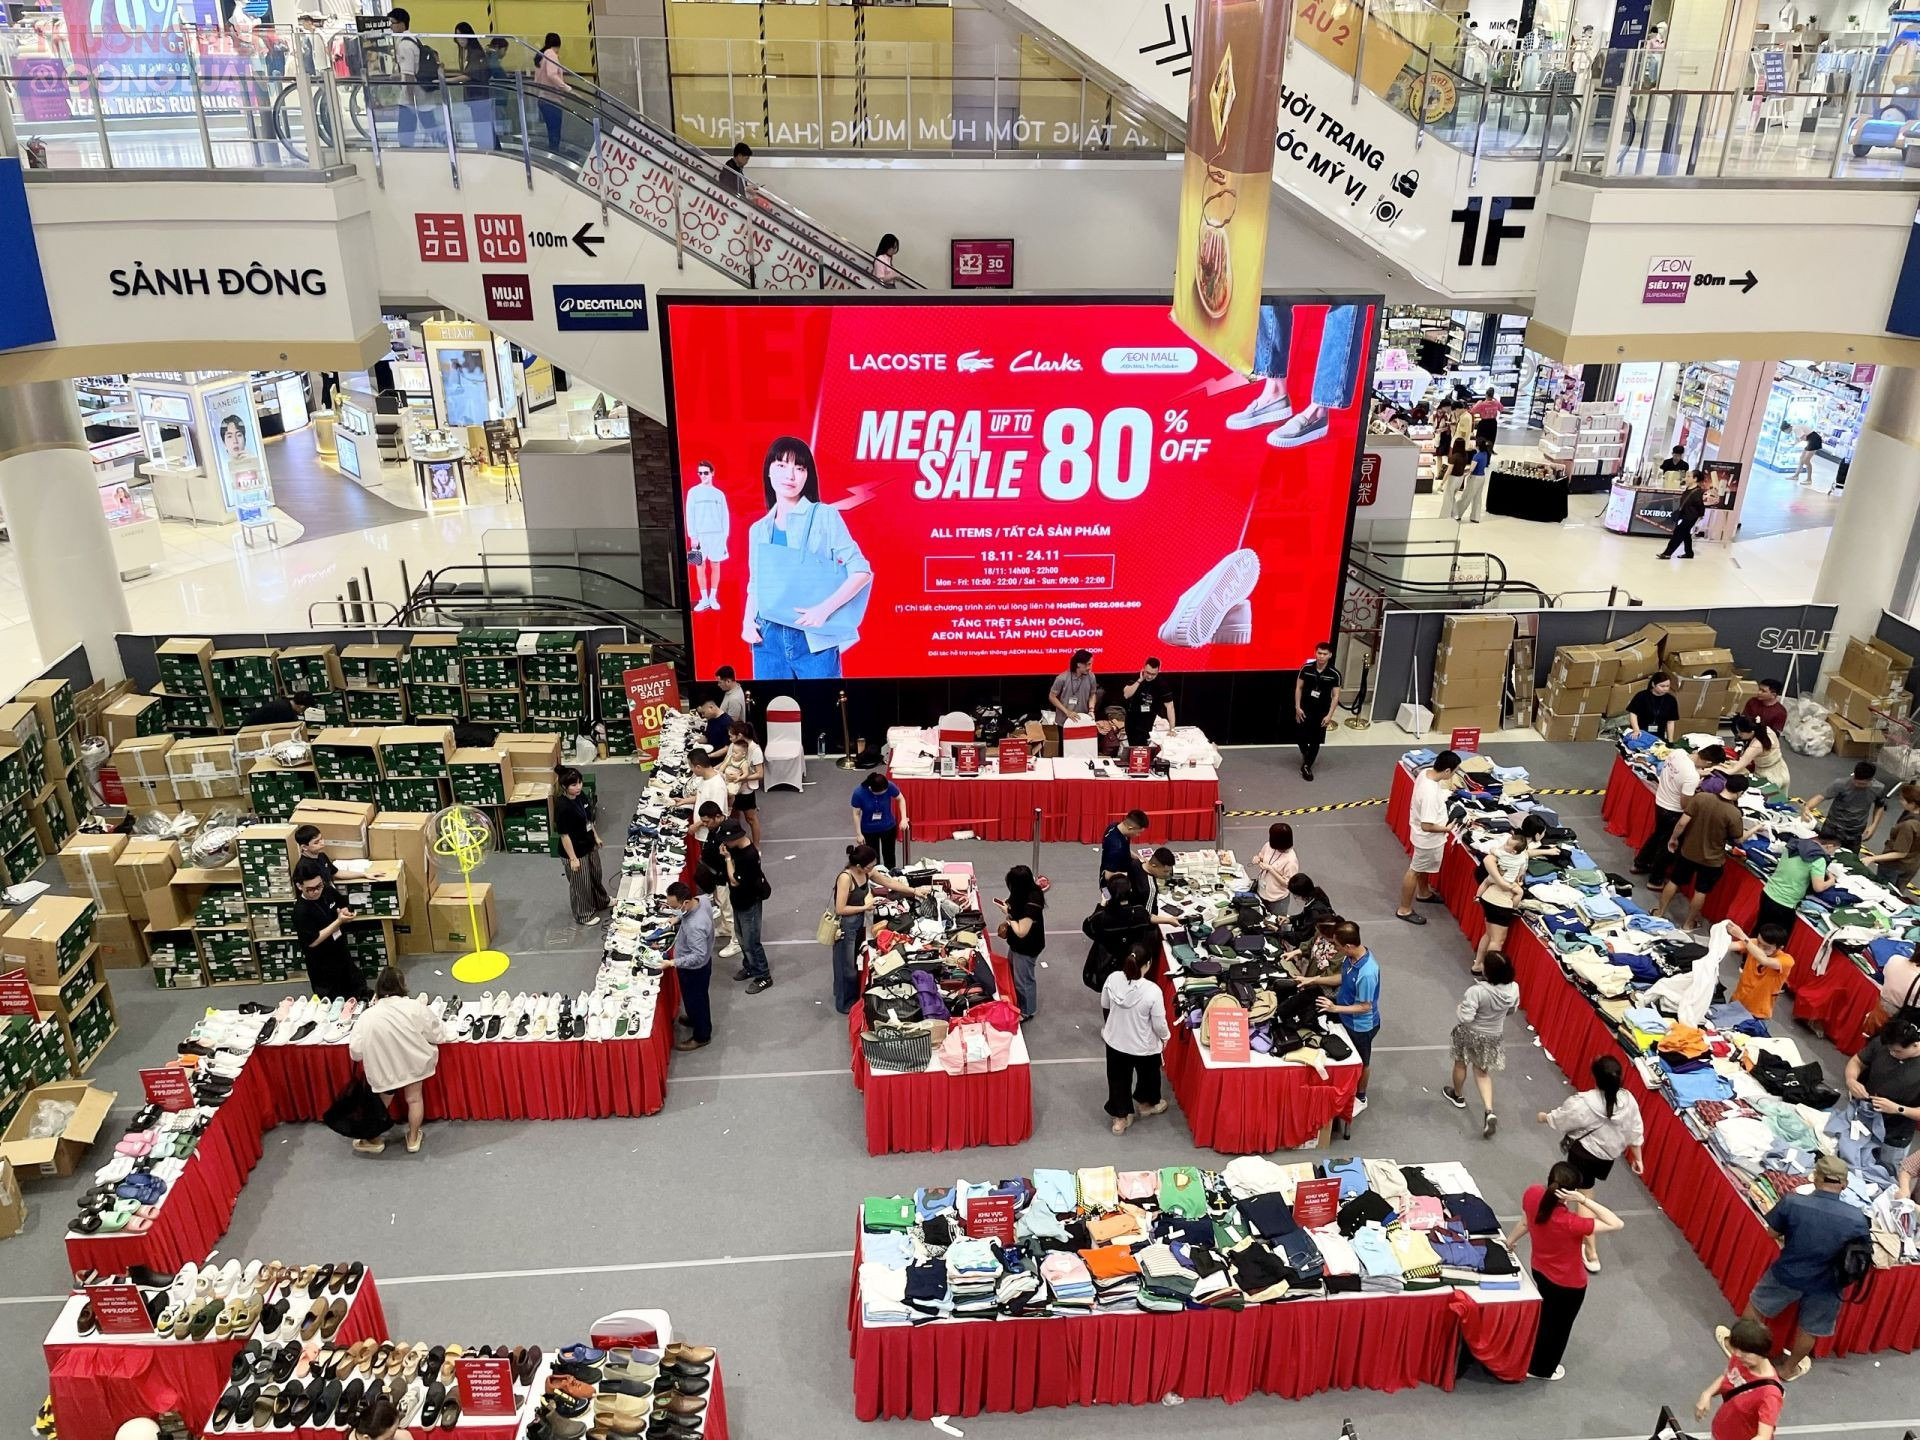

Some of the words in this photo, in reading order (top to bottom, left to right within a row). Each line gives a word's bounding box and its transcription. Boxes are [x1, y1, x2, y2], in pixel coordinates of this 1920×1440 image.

[1333, 25, 1351, 46] 2
[114, 96, 167, 114] THAT'S
[1280, 84, 1317, 125] HỜI
[1316, 112, 1386, 172] TRANG
[1277, 127, 1309, 162] ÓC
[1306, 151, 1346, 185] MỸ
[1343, 175, 1368, 207] VỊ
[629, 200, 668, 229] TOKYO
[423, 219, 459, 236] ユニ
[480, 218, 516, 236] UNI
[1451, 196, 1536, 266] 1F
[425, 239, 462, 257] クロ
[482, 238, 522, 259] QLO
[528, 231, 569, 249] 100m
[681, 230, 714, 256] OKYO
[988, 258, 1004, 269] 30
[109, 260, 210, 297] SẢNH
[217, 261, 327, 297] ĐÔNG
[1647, 279, 1670, 290] SIÊU
[1671, 281, 1687, 292] THỊ
[1694, 273, 1726, 287] 80m
[491, 286, 524, 301] MUJI
[576, 299, 643, 311] DECATHLON
[440, 326, 475, 340] ELIXIR
[849, 353, 947, 371] LACOSTE
[1008, 349, 1083, 373] Clarks
[1150, 352, 1179, 362] MALL
[213, 395, 243, 410] LANEIGE
[990, 413, 1010, 433] UP
[1012, 413, 1032, 432] TO
[1163, 409, 1189, 433] %
[855, 408, 982, 461] MEGA
[1038, 406, 1154, 501] 80
[1159, 438, 1211, 462] OFF
[914, 449, 1029, 499] SALE
[1639, 509, 1673, 518] LIXIBOX
[930, 527, 953, 538] ALL
[955, 527, 993, 538] ITEMS
[995, 527, 1000, 538] /
[1003, 525, 1025, 538] TẤT
[1027, 523, 1045, 537] CẢ
[1047, 523, 1073, 537] SẢN
[980, 551, 1014, 561] 18.11
[1026, 550, 1059, 561] 24.11
[984, 567, 1007, 575] 18/11:
[1009, 567, 1030, 575] 14h00
[1036, 567, 1059, 575] 22h00
[957, 578, 970, 586] Fri:
[971, 578, 991, 586] 10:00
[997, 578, 1017, 586] 22:00
[1023, 577, 1036, 585] Sat
[1042, 577, 1058, 585] Sun:
[1059, 576, 1079, 584] 09:00
[1085, 576, 1106, 584] 22:00
[1014, 616, 1045, 627] SẢNH
[931, 631, 963, 640] AEON
[966, 631, 996, 640] MALL
[999, 629, 1021, 639] TÂN
[1050, 629, 1104, 638] CELADON
[1757, 627, 1841, 652] SALE
[630, 679, 672, 694] PRIVATE
[640, 688, 665, 700] SALE
[643, 703, 669, 730] 80
